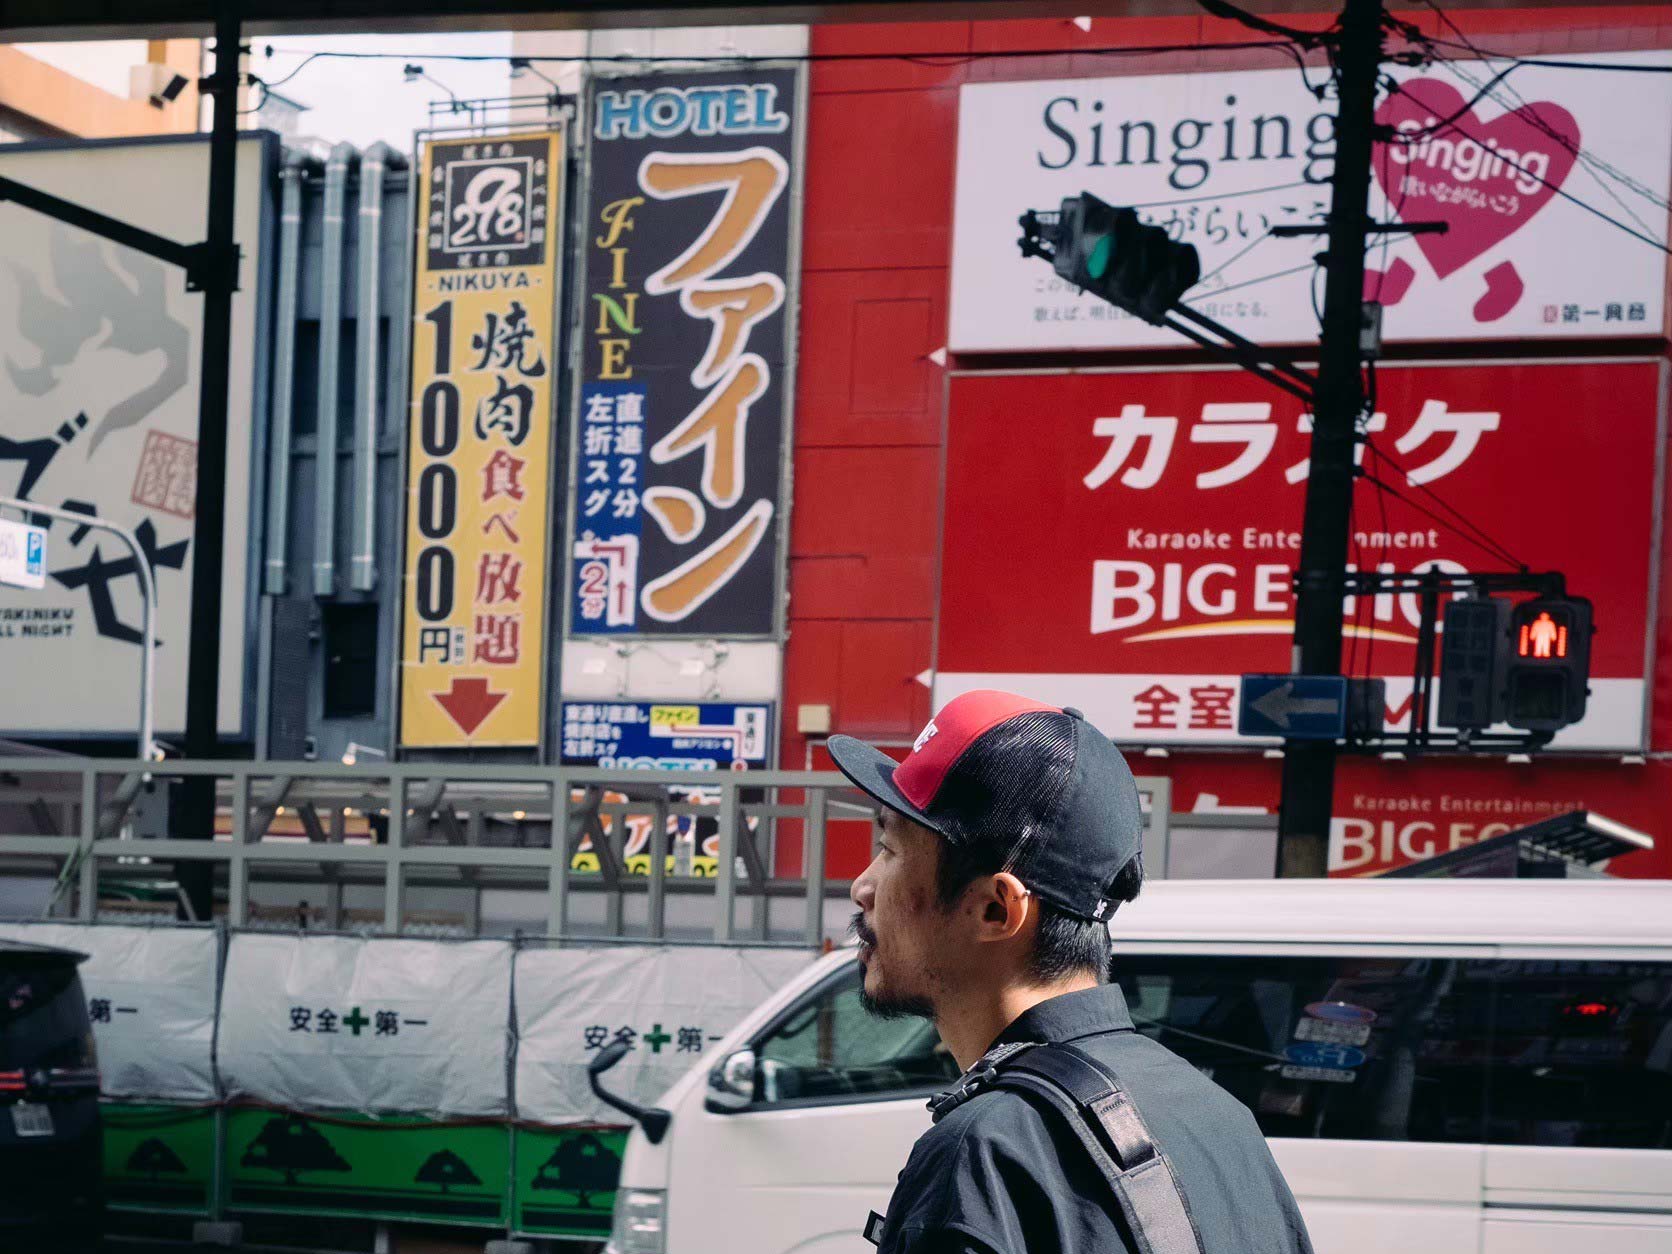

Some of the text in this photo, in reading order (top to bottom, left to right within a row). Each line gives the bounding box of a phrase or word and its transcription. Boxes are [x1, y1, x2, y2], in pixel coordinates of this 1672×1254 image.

[595, 83, 790, 139] HOTEL
[1038, 94, 1337, 190] Singing
[1390, 117, 1549, 195] Singing
[439, 272, 529, 291] NIKUYA
[592, 196, 645, 380] FINE
[637, 146, 790, 622] ファイン
[470, 302, 546, 664] 焼肉食べ放題
[584, 393, 614, 517] 左折スグ
[612, 392, 645, 518] 直進2分
[1127, 527, 1438, 549] Karaoke Entenment
[0, 607, 74, 619] AKINIKU
[1091, 559, 1237, 634] BIG
[1133, 684, 1235, 730] 全室
[1353, 795, 1432, 812] Karaoke
[1327, 817, 1436, 872] BIG
[289, 1007, 428, 1036] 安全 第一
